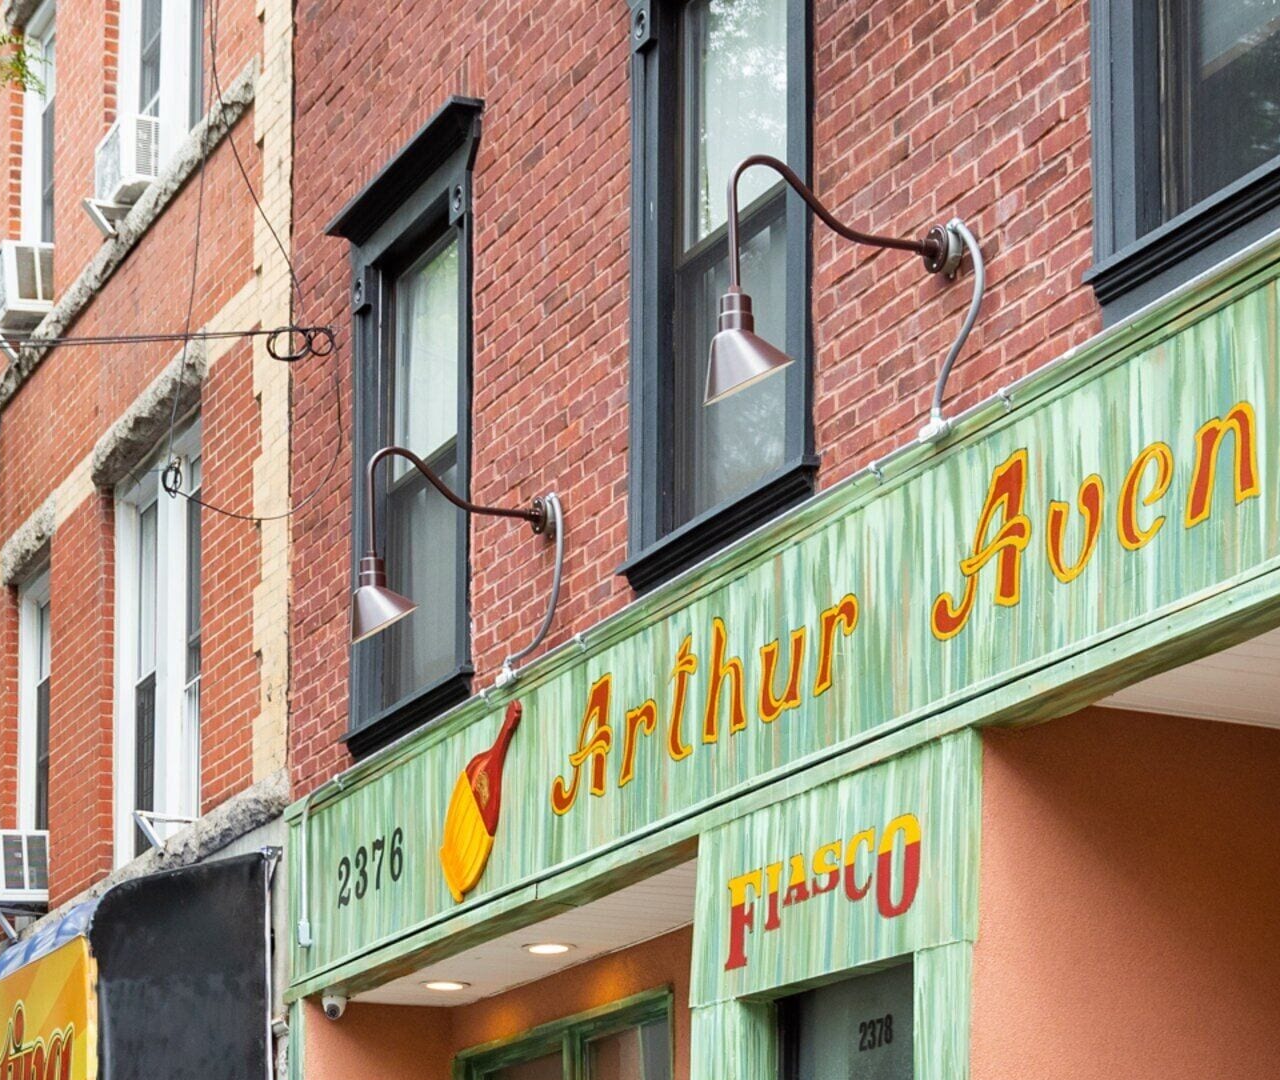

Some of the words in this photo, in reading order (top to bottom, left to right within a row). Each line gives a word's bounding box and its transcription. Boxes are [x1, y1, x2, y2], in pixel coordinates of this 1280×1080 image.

[551, 594, 859, 816] Arthur
[337, 826, 404, 909] 2376
[724, 812, 921, 971] FIASCO
[859, 1013, 893, 1052] 2378
